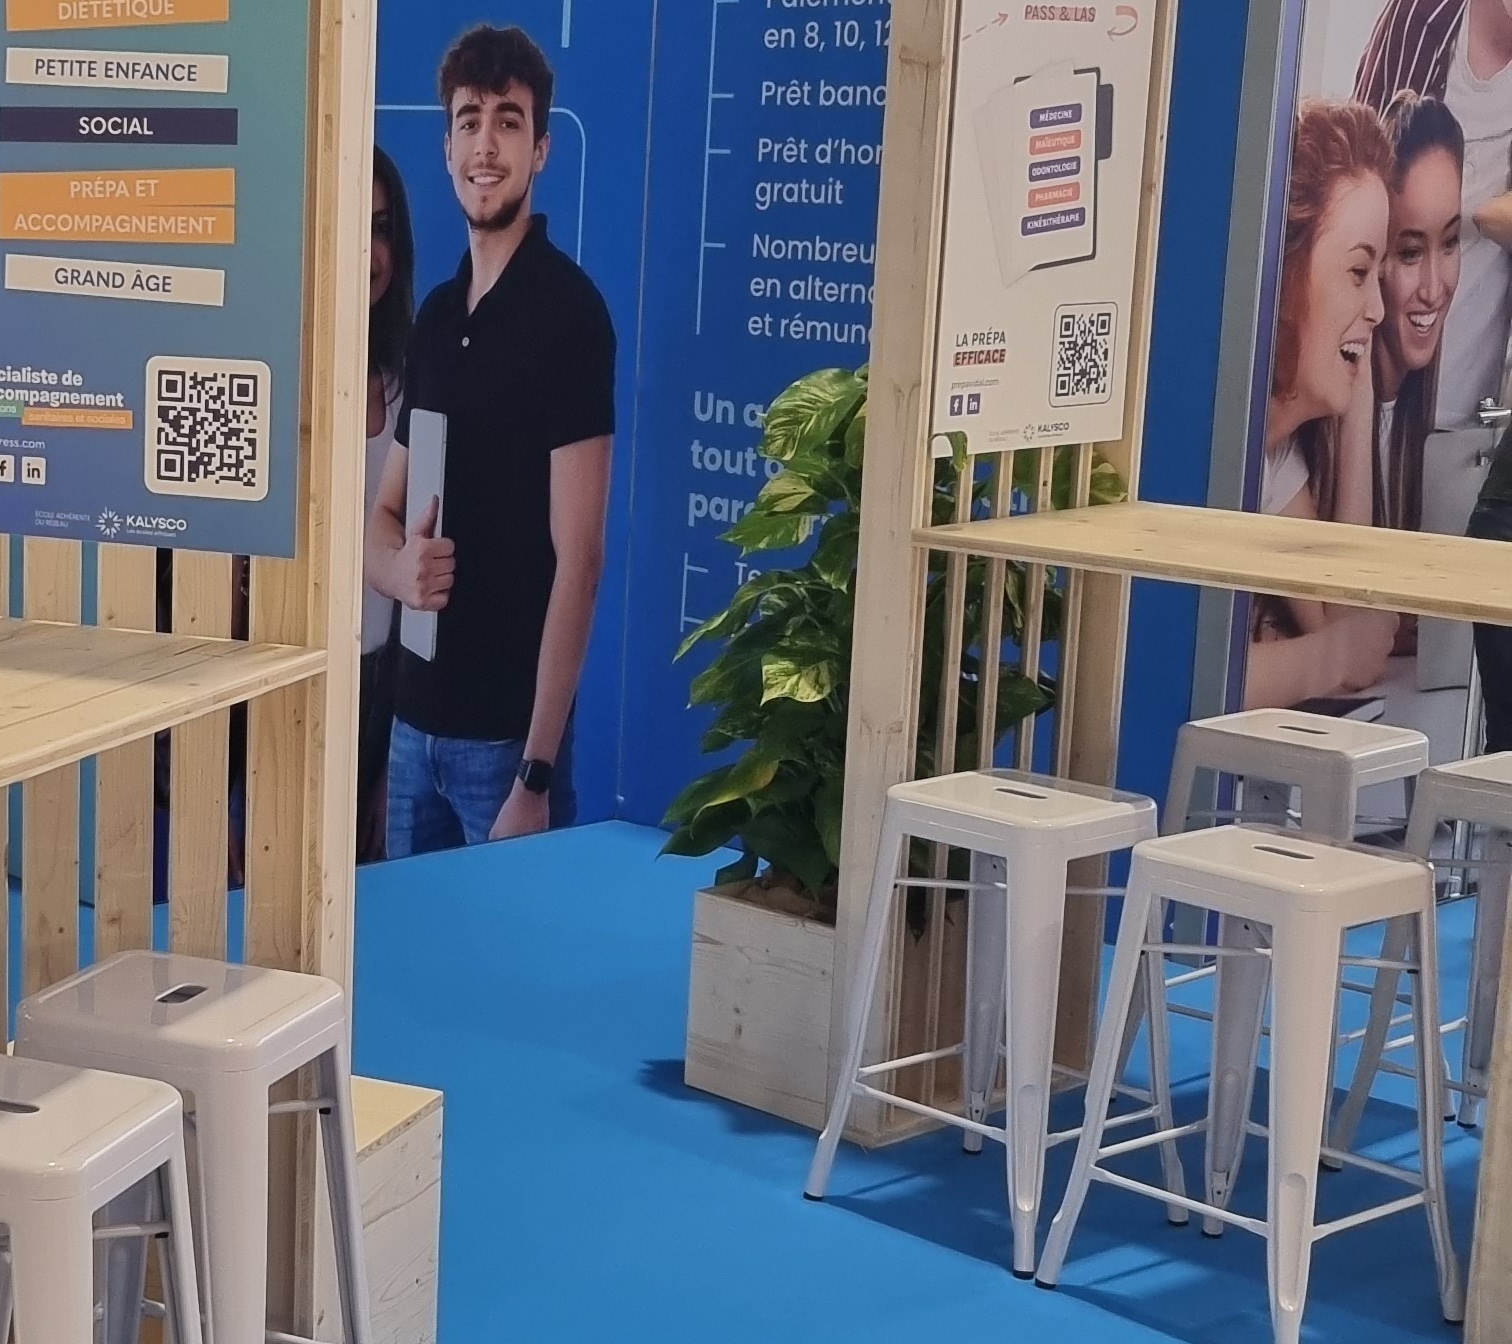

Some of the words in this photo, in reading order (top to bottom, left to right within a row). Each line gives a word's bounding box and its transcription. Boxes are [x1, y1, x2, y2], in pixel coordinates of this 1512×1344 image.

[1024, 5, 1055, 21] PASS
[1059, 7, 1070, 21] &
[1074, 7, 1096, 22] LAS
[764, 28, 795, 49] en
[803, 21, 825, 52] 8,
[834, 20, 866, 51] 10,
[35, 58, 98, 78] PETITE
[104, 61, 198, 82] ENFANCE
[761, 79, 811, 106] Prêt
[78, 116, 154, 135] SOCIAL
[758, 137, 808, 163] Prêt
[70, 176, 130, 199] PRÉPA
[135, 178, 159, 198] ET
[755, 177, 844, 211] gratuit
[13, 212, 217, 235] ACCOMPAGNEMENT
[54, 266, 125, 290] GRAND
[131, 269, 173, 293] ÂGE
[750, 277, 781, 298] en
[748, 313, 773, 337] et
[956, 333, 968, 347] LA
[972, 326, 1006, 346] PRÉPA
[954, 349, 1006, 366] EFFICACE
[61, 369, 83, 387] de
[76, 412, 85, 423] et
[694, 390, 735, 425] Un
[1037, 422, 1070, 433] KALYSCO
[690, 439, 757, 477] tout
[126, 515, 187, 532] KALYSCO
